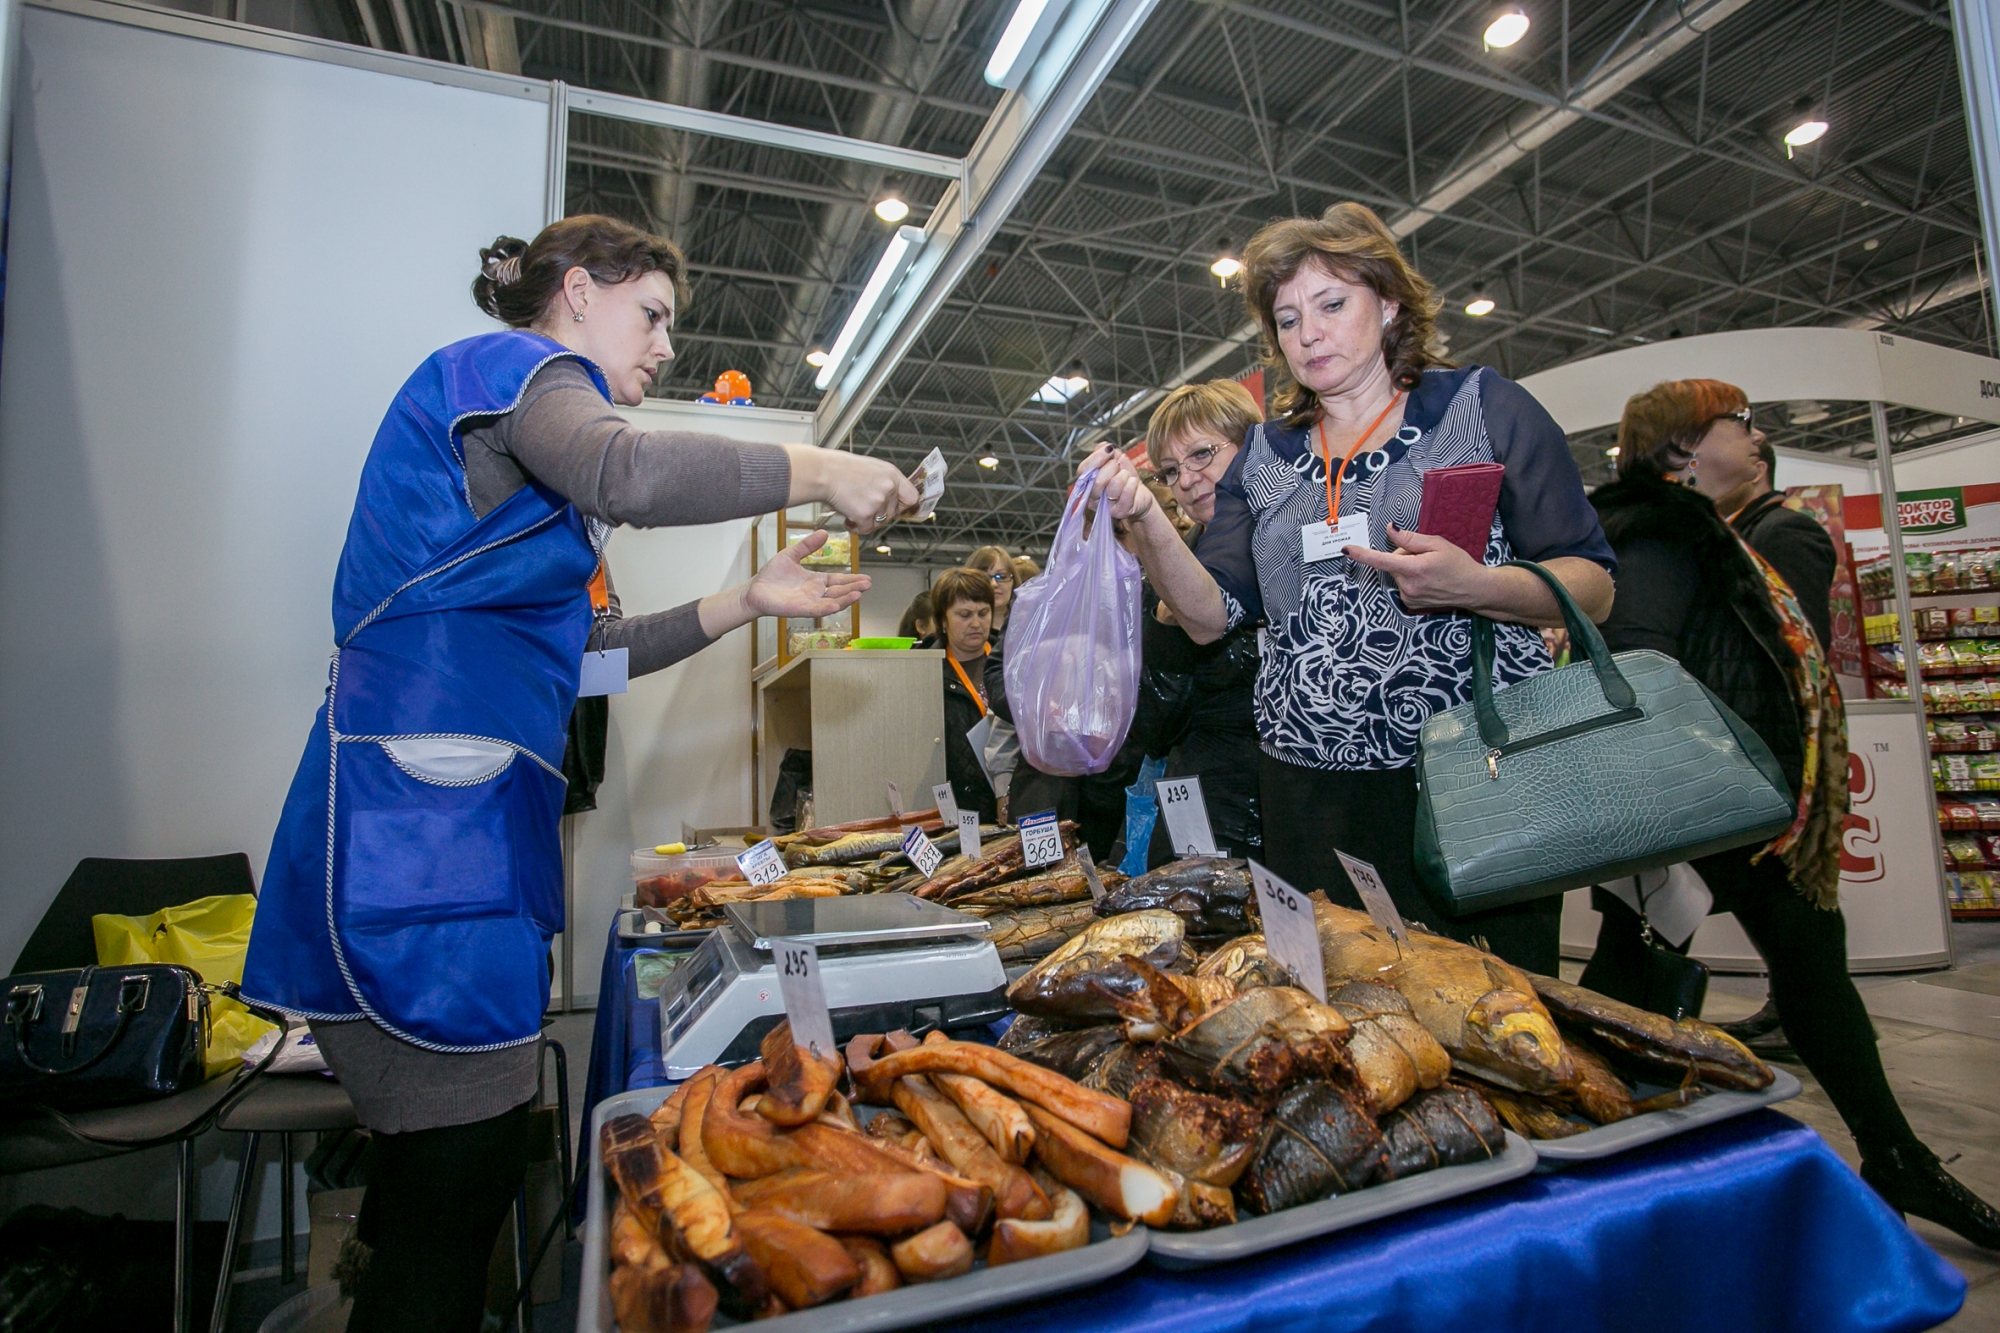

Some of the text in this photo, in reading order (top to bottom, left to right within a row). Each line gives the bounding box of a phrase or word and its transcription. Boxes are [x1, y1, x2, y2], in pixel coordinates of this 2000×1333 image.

[1167, 784, 1189, 804] 239
[962, 815, 976, 825] 355
[1025, 826, 1054, 837] ГОРБУША
[1352, 866, 1377, 889] 179
[1265, 879, 1298, 911] 360
